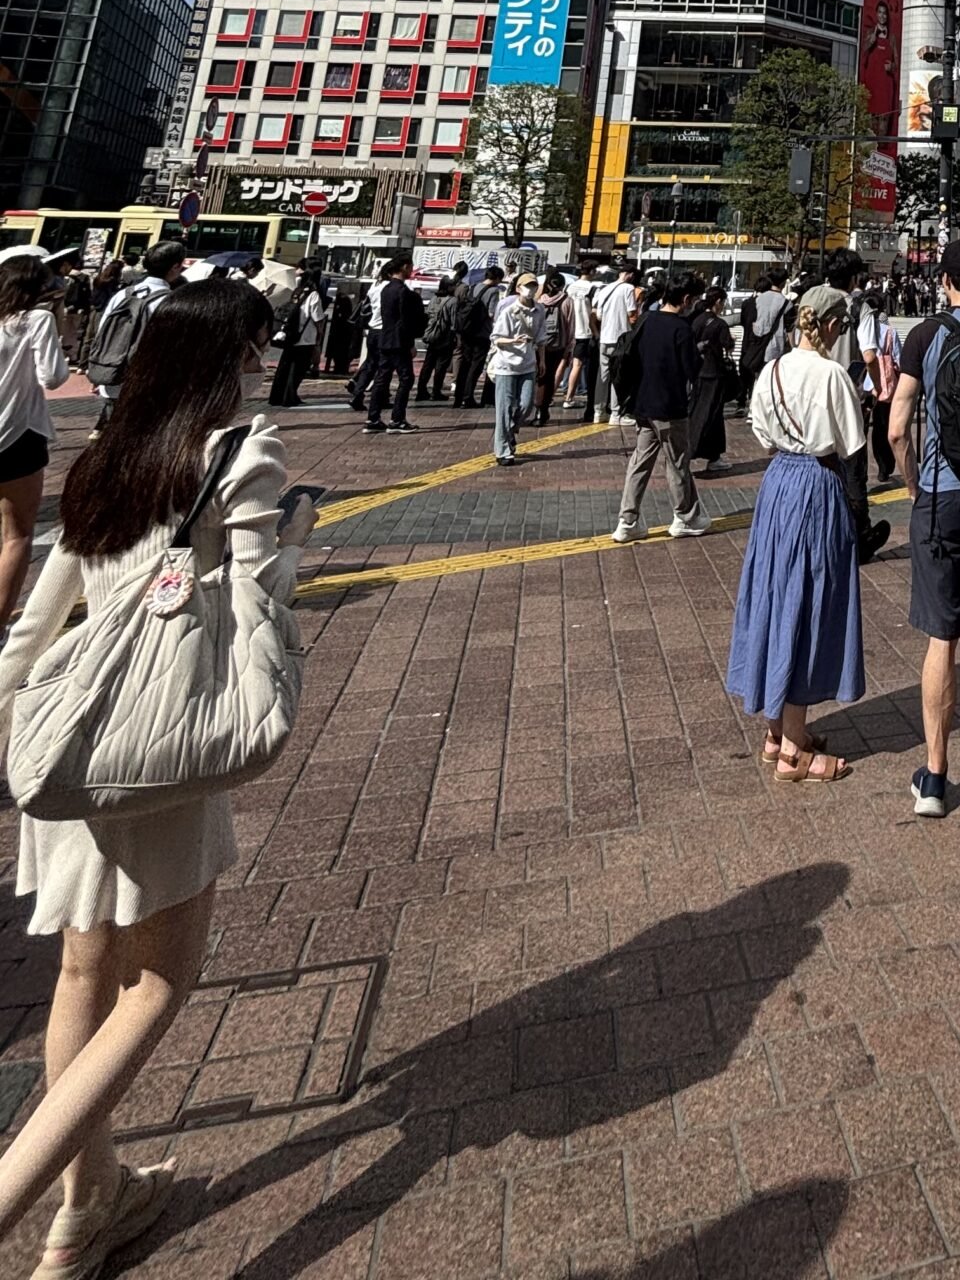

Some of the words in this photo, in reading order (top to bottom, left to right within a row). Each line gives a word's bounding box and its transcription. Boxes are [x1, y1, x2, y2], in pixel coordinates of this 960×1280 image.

[183, 64, 195, 72] 3F
[240, 177, 364, 204] サンドラッグ
